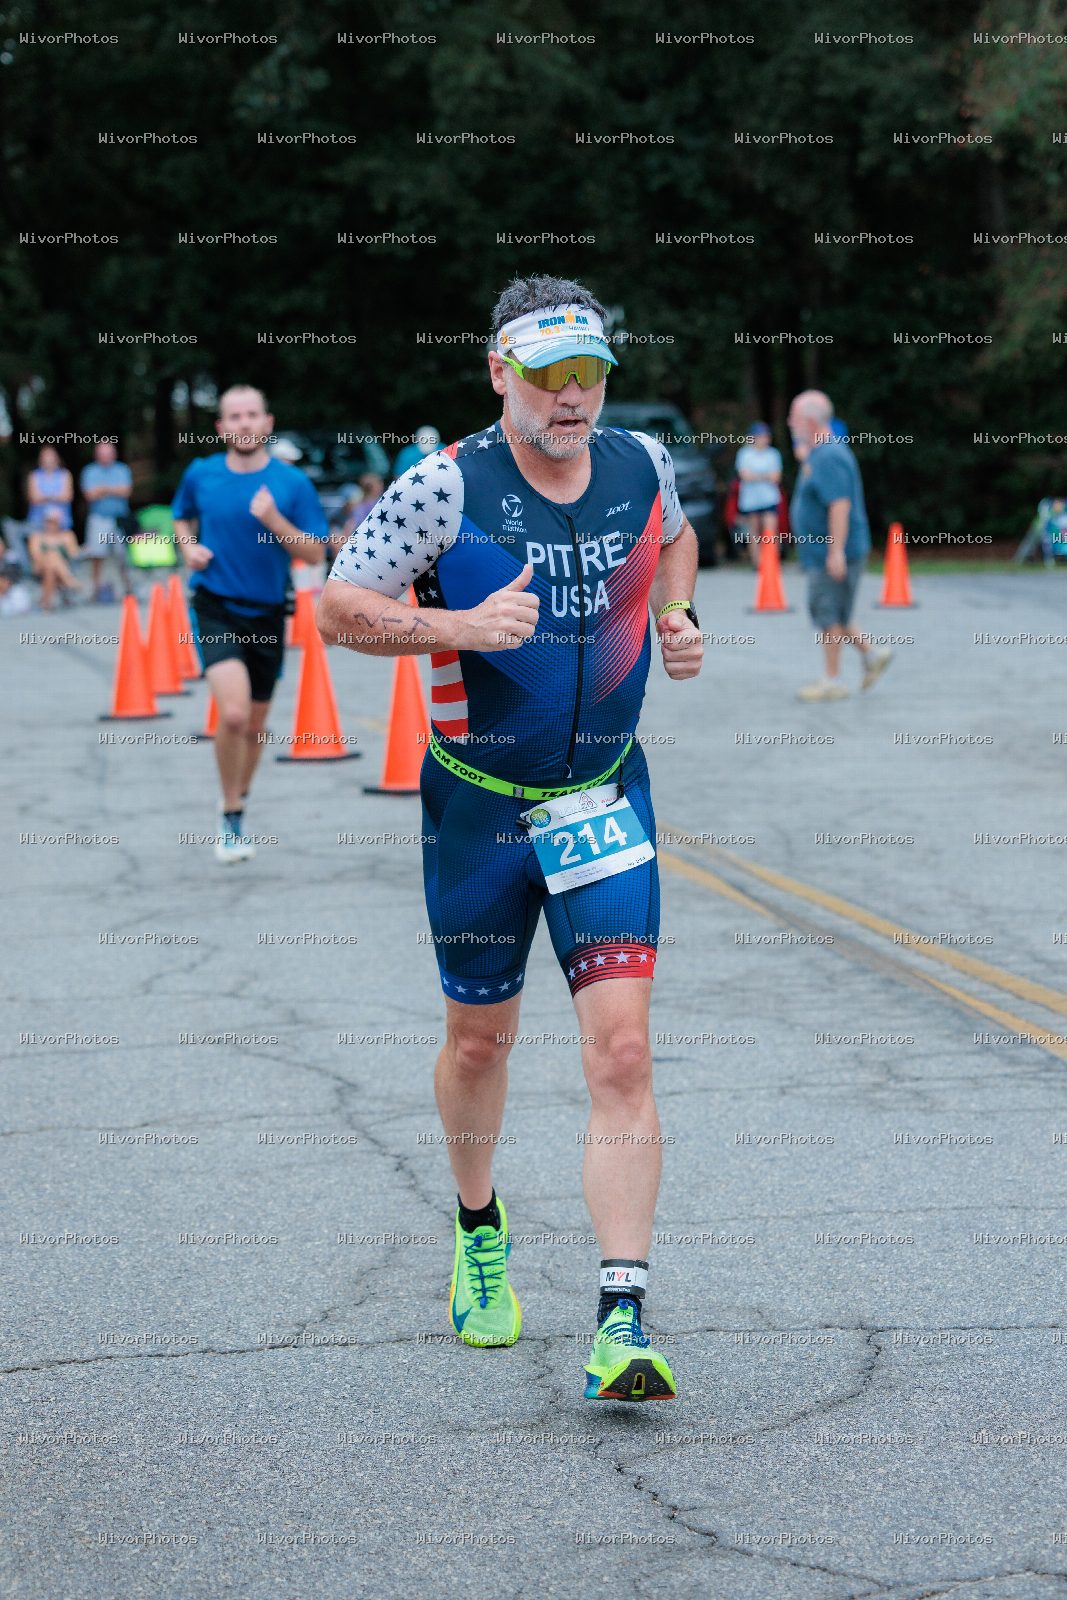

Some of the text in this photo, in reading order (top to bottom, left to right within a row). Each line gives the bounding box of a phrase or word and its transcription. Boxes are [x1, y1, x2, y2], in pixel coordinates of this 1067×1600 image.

[538, 310, 589, 329] IRONMAN
[502, 524, 528, 533] Triathlon
[505, 519, 523, 527] World
[526, 531, 627, 578] PITRE
[551, 580, 610, 618] USA
[451, 763, 486, 783] ZOOT
[553, 816, 627, 867] 214
[605, 1271, 632, 1283] MYL
